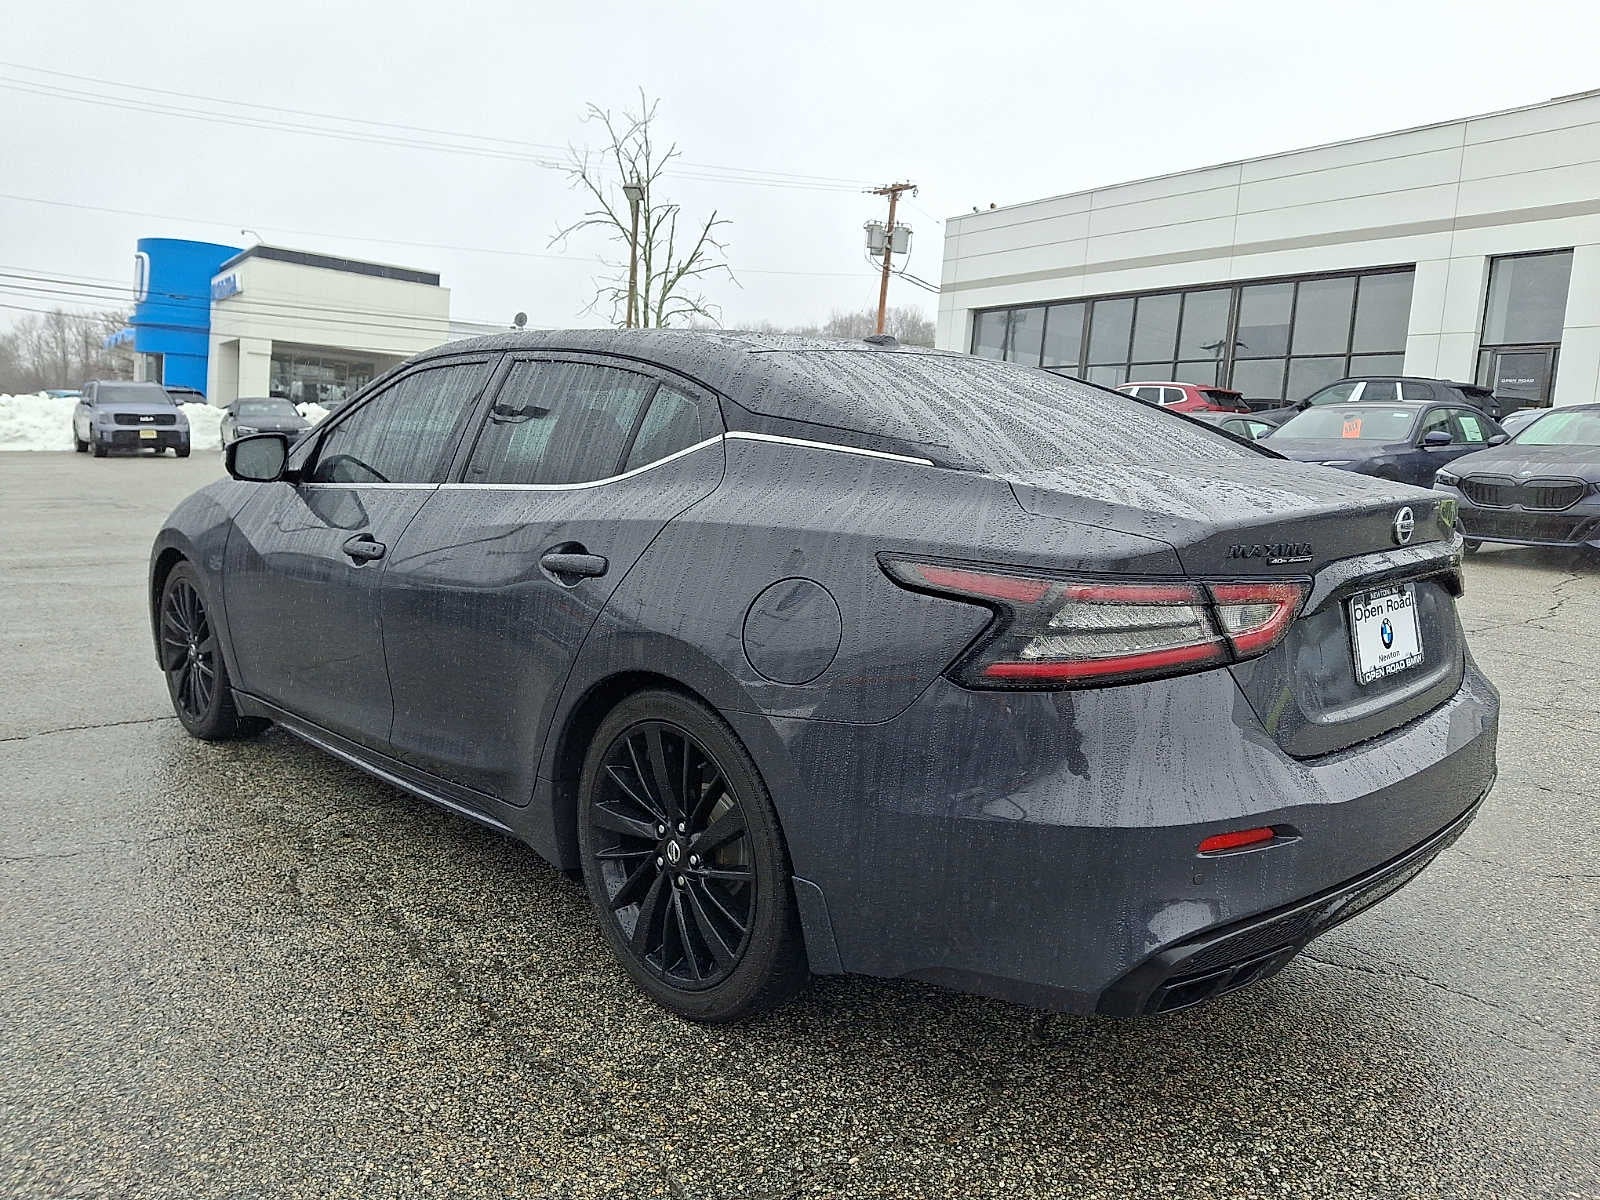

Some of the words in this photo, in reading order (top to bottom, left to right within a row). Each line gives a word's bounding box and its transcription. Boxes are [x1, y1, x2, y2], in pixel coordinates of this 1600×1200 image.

[1225, 543, 1312, 559] MAXIMA
[1354, 605, 1383, 623] Open
[1386, 596, 1411, 613] Road
[1379, 650, 1400, 663] Newton
[1366, 668, 1384, 682] OPEN
[1385, 660, 1405, 675] ROAD
[1406, 653, 1422, 667] BMW
